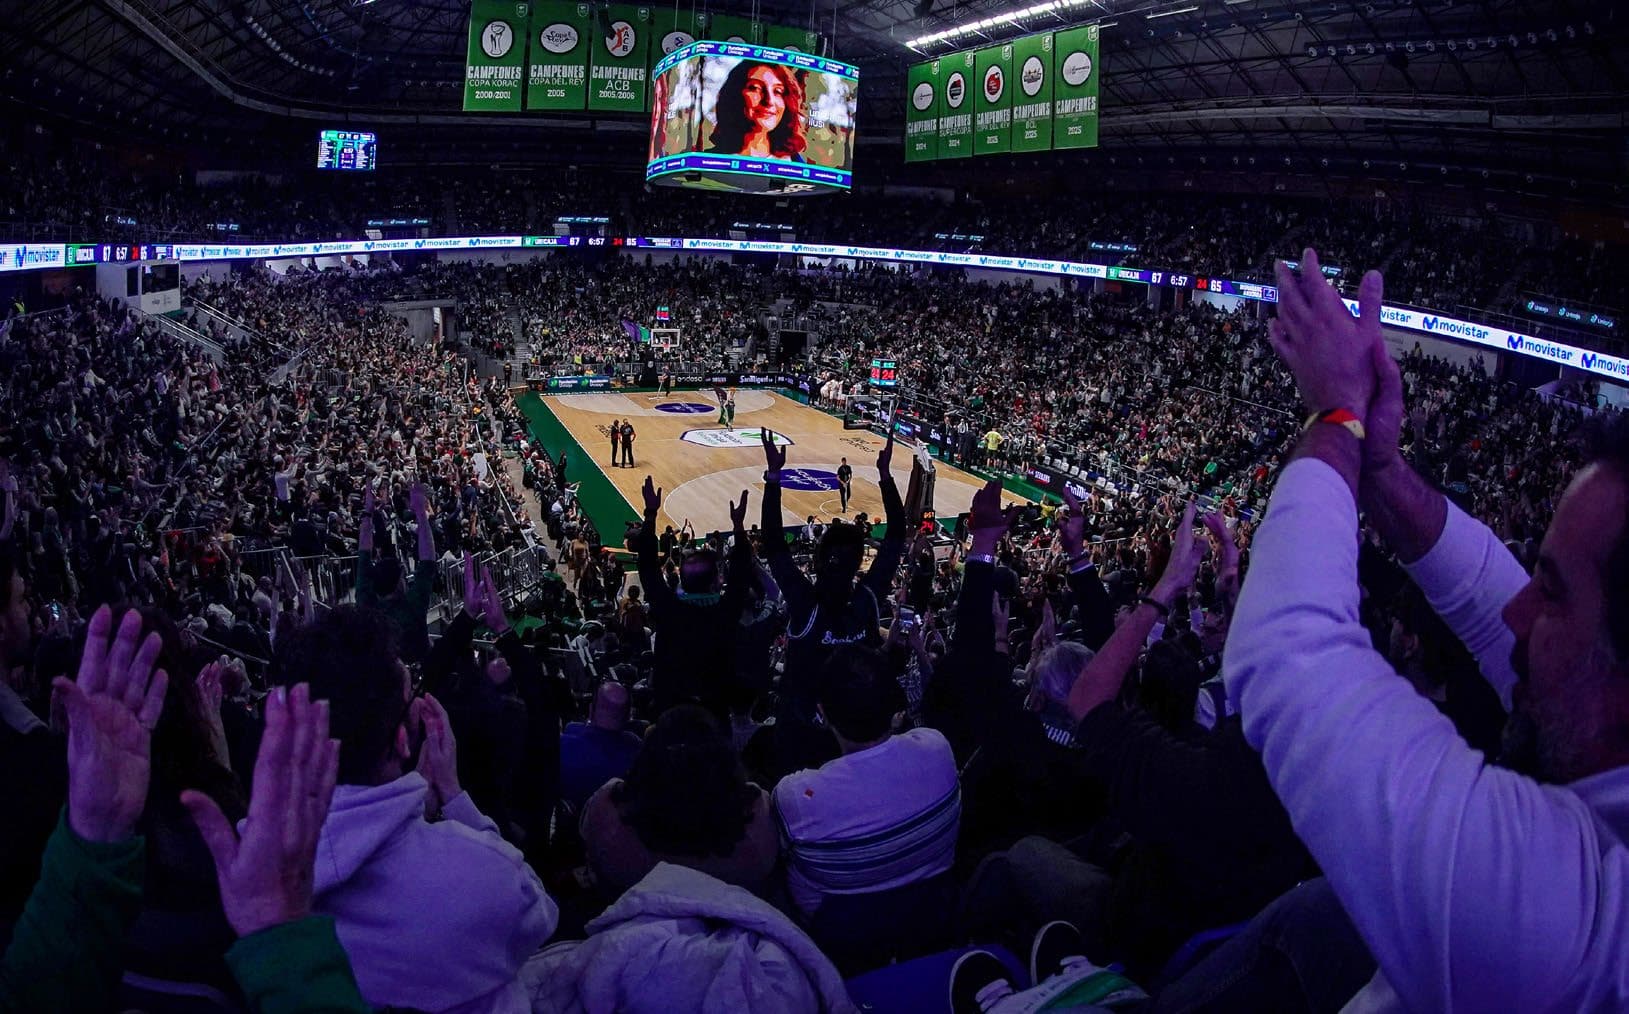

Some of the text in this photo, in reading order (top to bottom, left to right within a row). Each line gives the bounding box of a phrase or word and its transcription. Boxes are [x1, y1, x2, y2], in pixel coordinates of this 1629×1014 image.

[468, 66, 521, 79] CAMPEONES
[531, 65, 584, 78] CAMPEONES
[592, 66, 644, 80] CAMPEONES
[606, 80, 630, 90] ACB
[1013, 102, 1050, 119] CAMPEONES
[1056, 96, 1096, 114] CAMPEONES
[939, 114, 971, 129] CAMPEONES
[977, 108, 1010, 125] CAMPEONES
[908, 119, 937, 133] CAMPEONES
[25, 246, 60, 263] movistar
[321, 243, 352, 251] movistar
[1071, 266, 1101, 275] movistar
[1151, 273, 1162, 283] 67
[1170, 275, 1188, 286] 6:57
[1197, 279, 1207, 289] 24
[1211, 280, 1222, 292] 65
[1380, 308, 1412, 323] vistar
[1440, 321, 1489, 339] movistar
[1525, 341, 1573, 360] movistar
[1598, 358, 1626, 375] movis
[882, 369, 895, 380] 24
